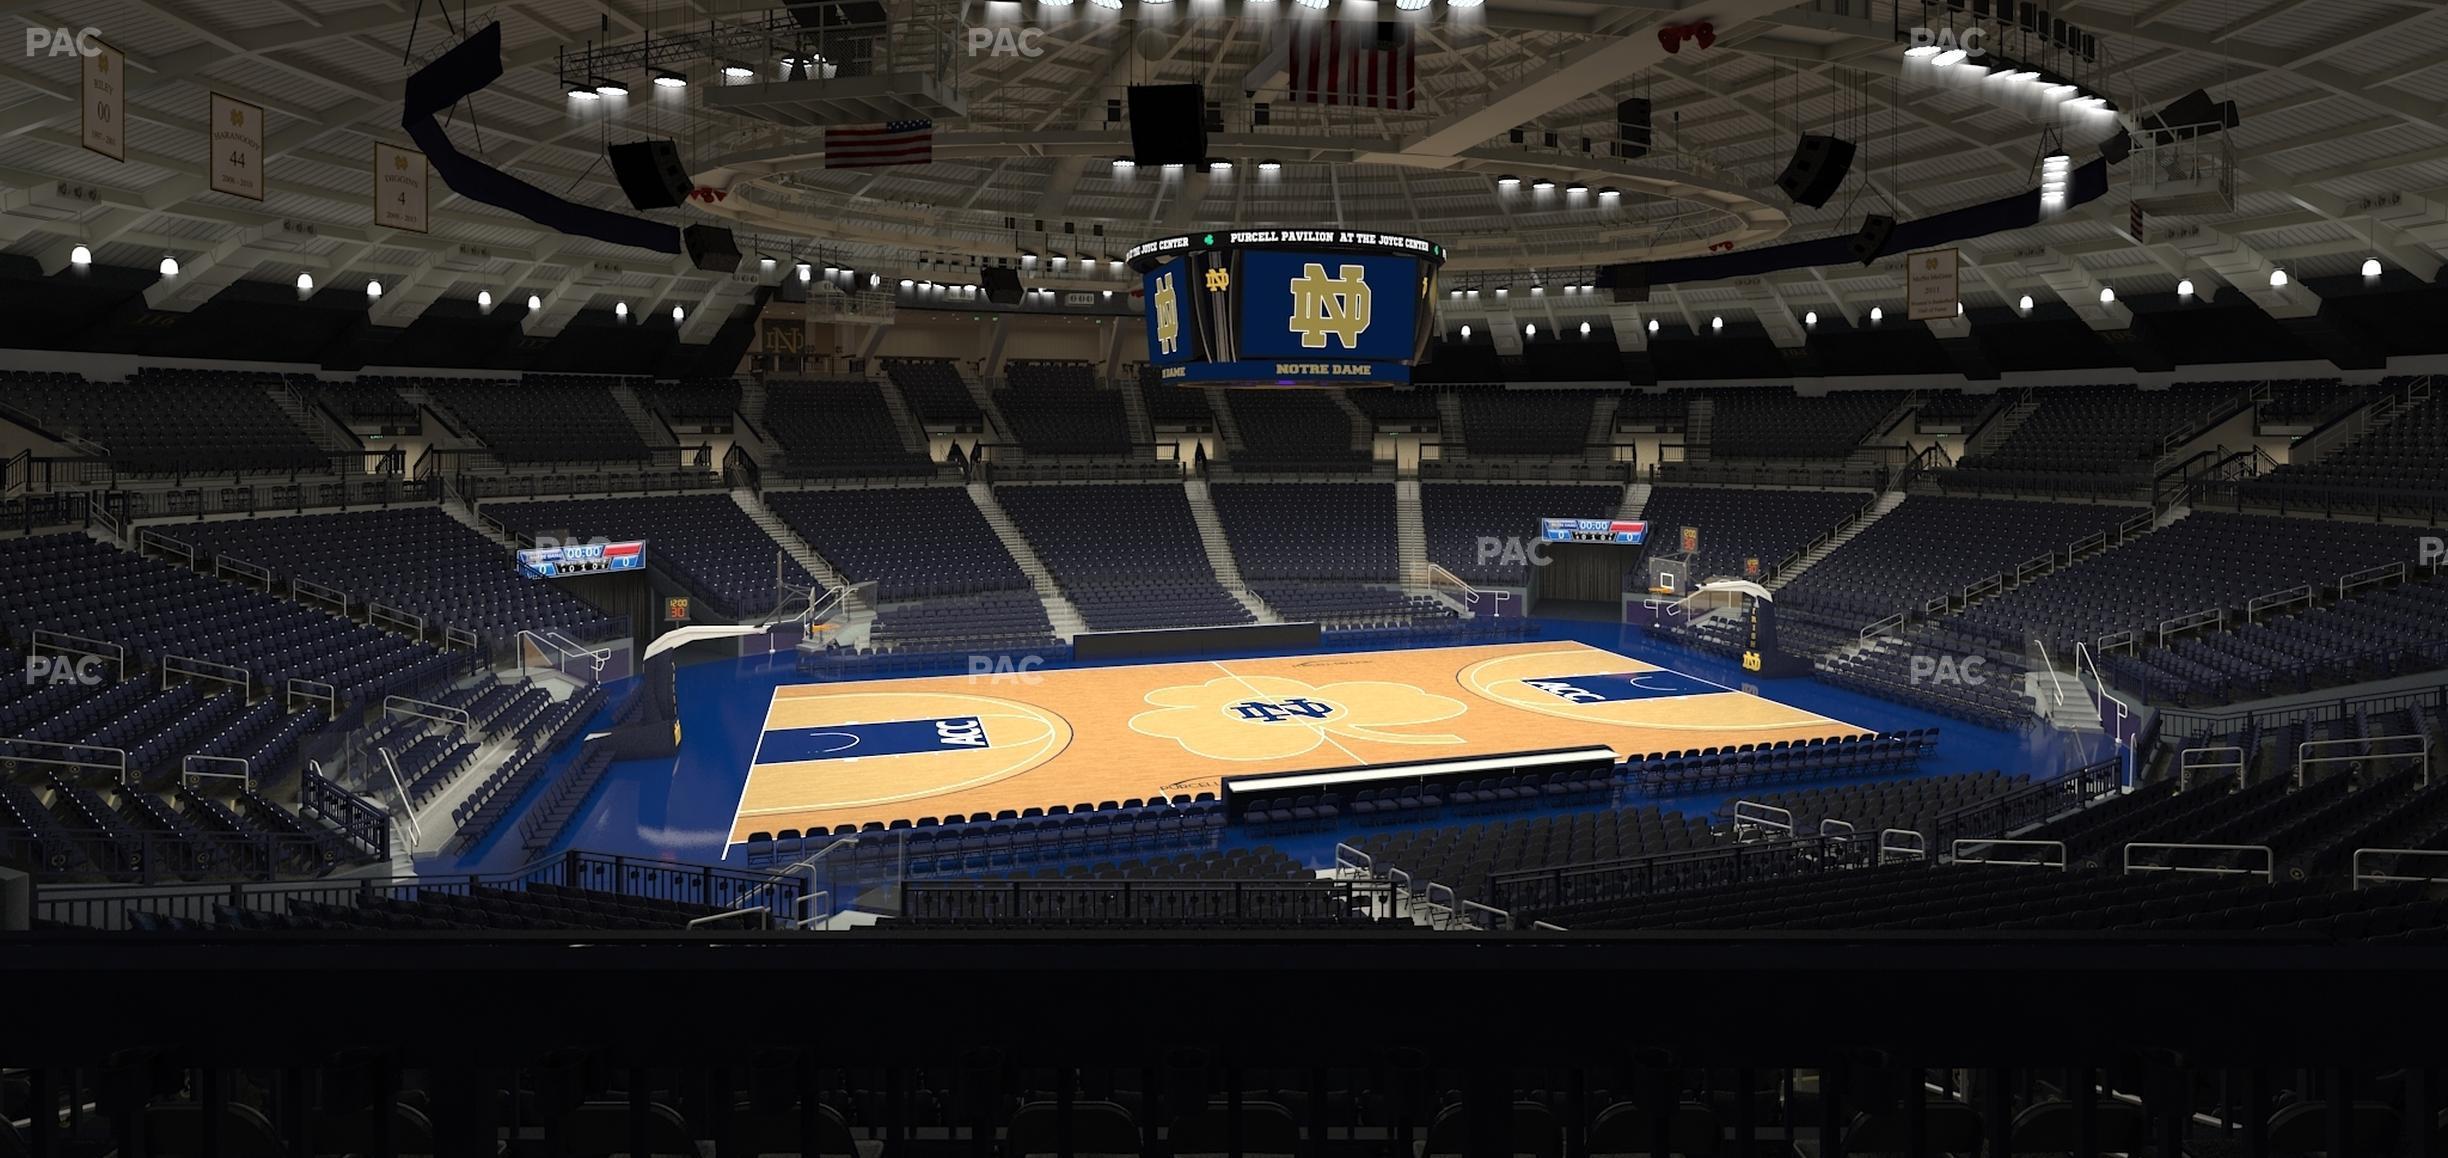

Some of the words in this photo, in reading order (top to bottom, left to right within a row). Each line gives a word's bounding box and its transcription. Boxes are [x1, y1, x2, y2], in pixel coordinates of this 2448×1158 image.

[97, 101, 111, 123] 00
[229, 151, 245, 168] 44
[397, 192, 406, 206] 4
[1141, 242, 1158, 254] JOYCE
[1159, 237, 1189, 250] CENTER
[1230, 231, 1279, 243] PURCELL
[1281, 231, 1334, 242] PAVILION
[1339, 232, 1354, 243] AT
[1356, 233, 1376, 244] THE
[1378, 235, 1404, 247] JOYCE
[1405, 238, 1429, 252] CENTER
[1276, 364, 1330, 376] NOTRE
[1332, 364, 1372, 376] DAME
[1580, 521, 1608, 530] 00:00
[1558, 531, 1564, 539] 0
[1626, 532, 1633, 541] 0
[567, 546, 600, 558] 00:00
[569, 565, 575, 573] 0
[592, 562, 598, 570] 0
[622, 557, 629, 567] 0
[539, 565, 546, 574] 0
[671, 607, 684, 618] 30
[1527, 681, 1606, 702] ACC
[935, 720, 986, 746] ACC
